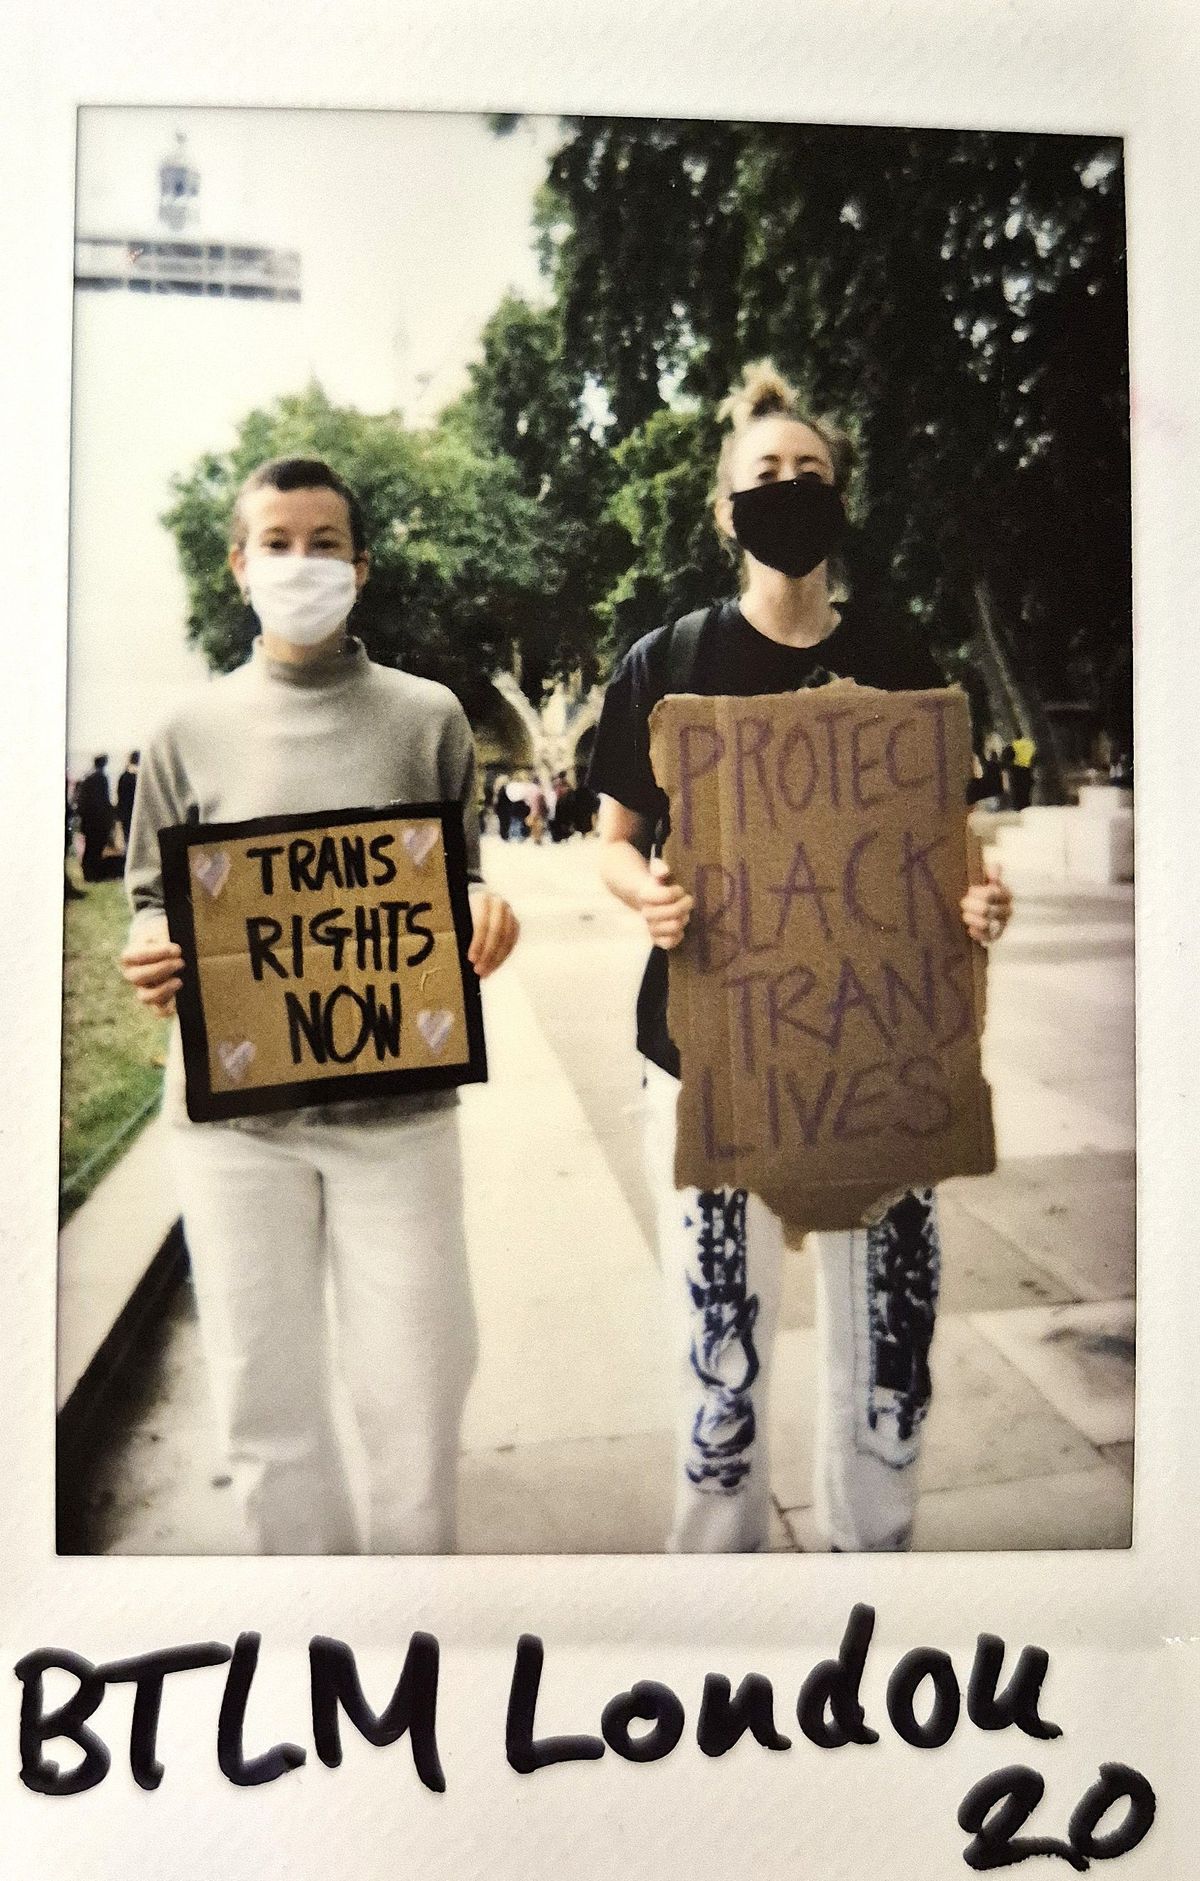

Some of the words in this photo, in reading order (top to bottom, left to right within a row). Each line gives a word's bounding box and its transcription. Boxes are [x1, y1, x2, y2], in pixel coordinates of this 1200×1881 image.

[679, 700, 955, 850] PROTECT
[247, 834, 397, 895] TRANS
[694, 831, 955, 975] BLACK
[246, 901, 435, 980] RIGHTS
[285, 983, 402, 1065] NOW
[721, 946, 974, 1074] TRANS
[702, 1053, 953, 1162] LIVES
[14, 1632, 446, 1796] BTLM
[505, 1602, 1063, 1774] London
[957, 1760, 1157, 1871] 20
